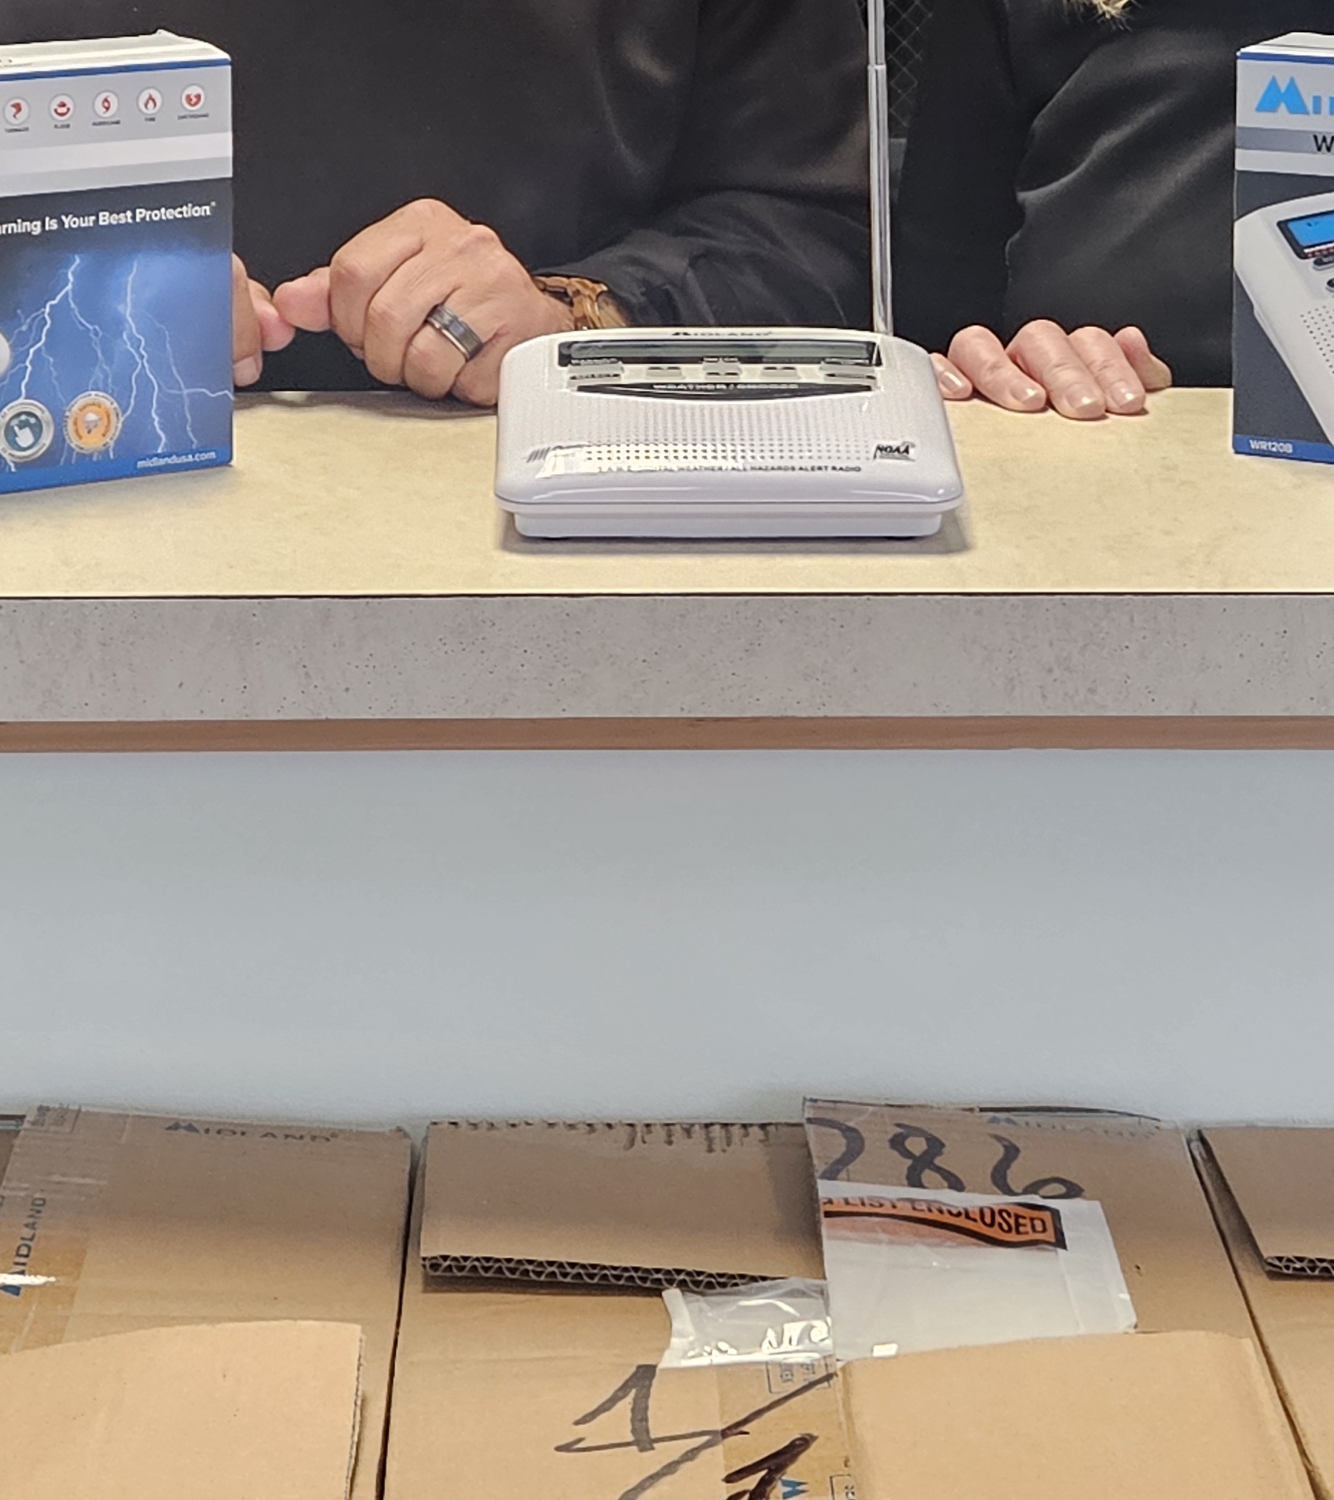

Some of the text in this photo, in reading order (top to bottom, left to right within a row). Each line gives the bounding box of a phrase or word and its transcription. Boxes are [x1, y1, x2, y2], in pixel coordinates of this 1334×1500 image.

[45, 216, 58, 231] Is
[61, 213, 96, 230] Your
[98, 210, 133, 226] Best
[136, 202, 211, 223] Protection
[1248, 439, 1294, 454] WR120B
[137, 450, 216, 469] midlandusa.com
